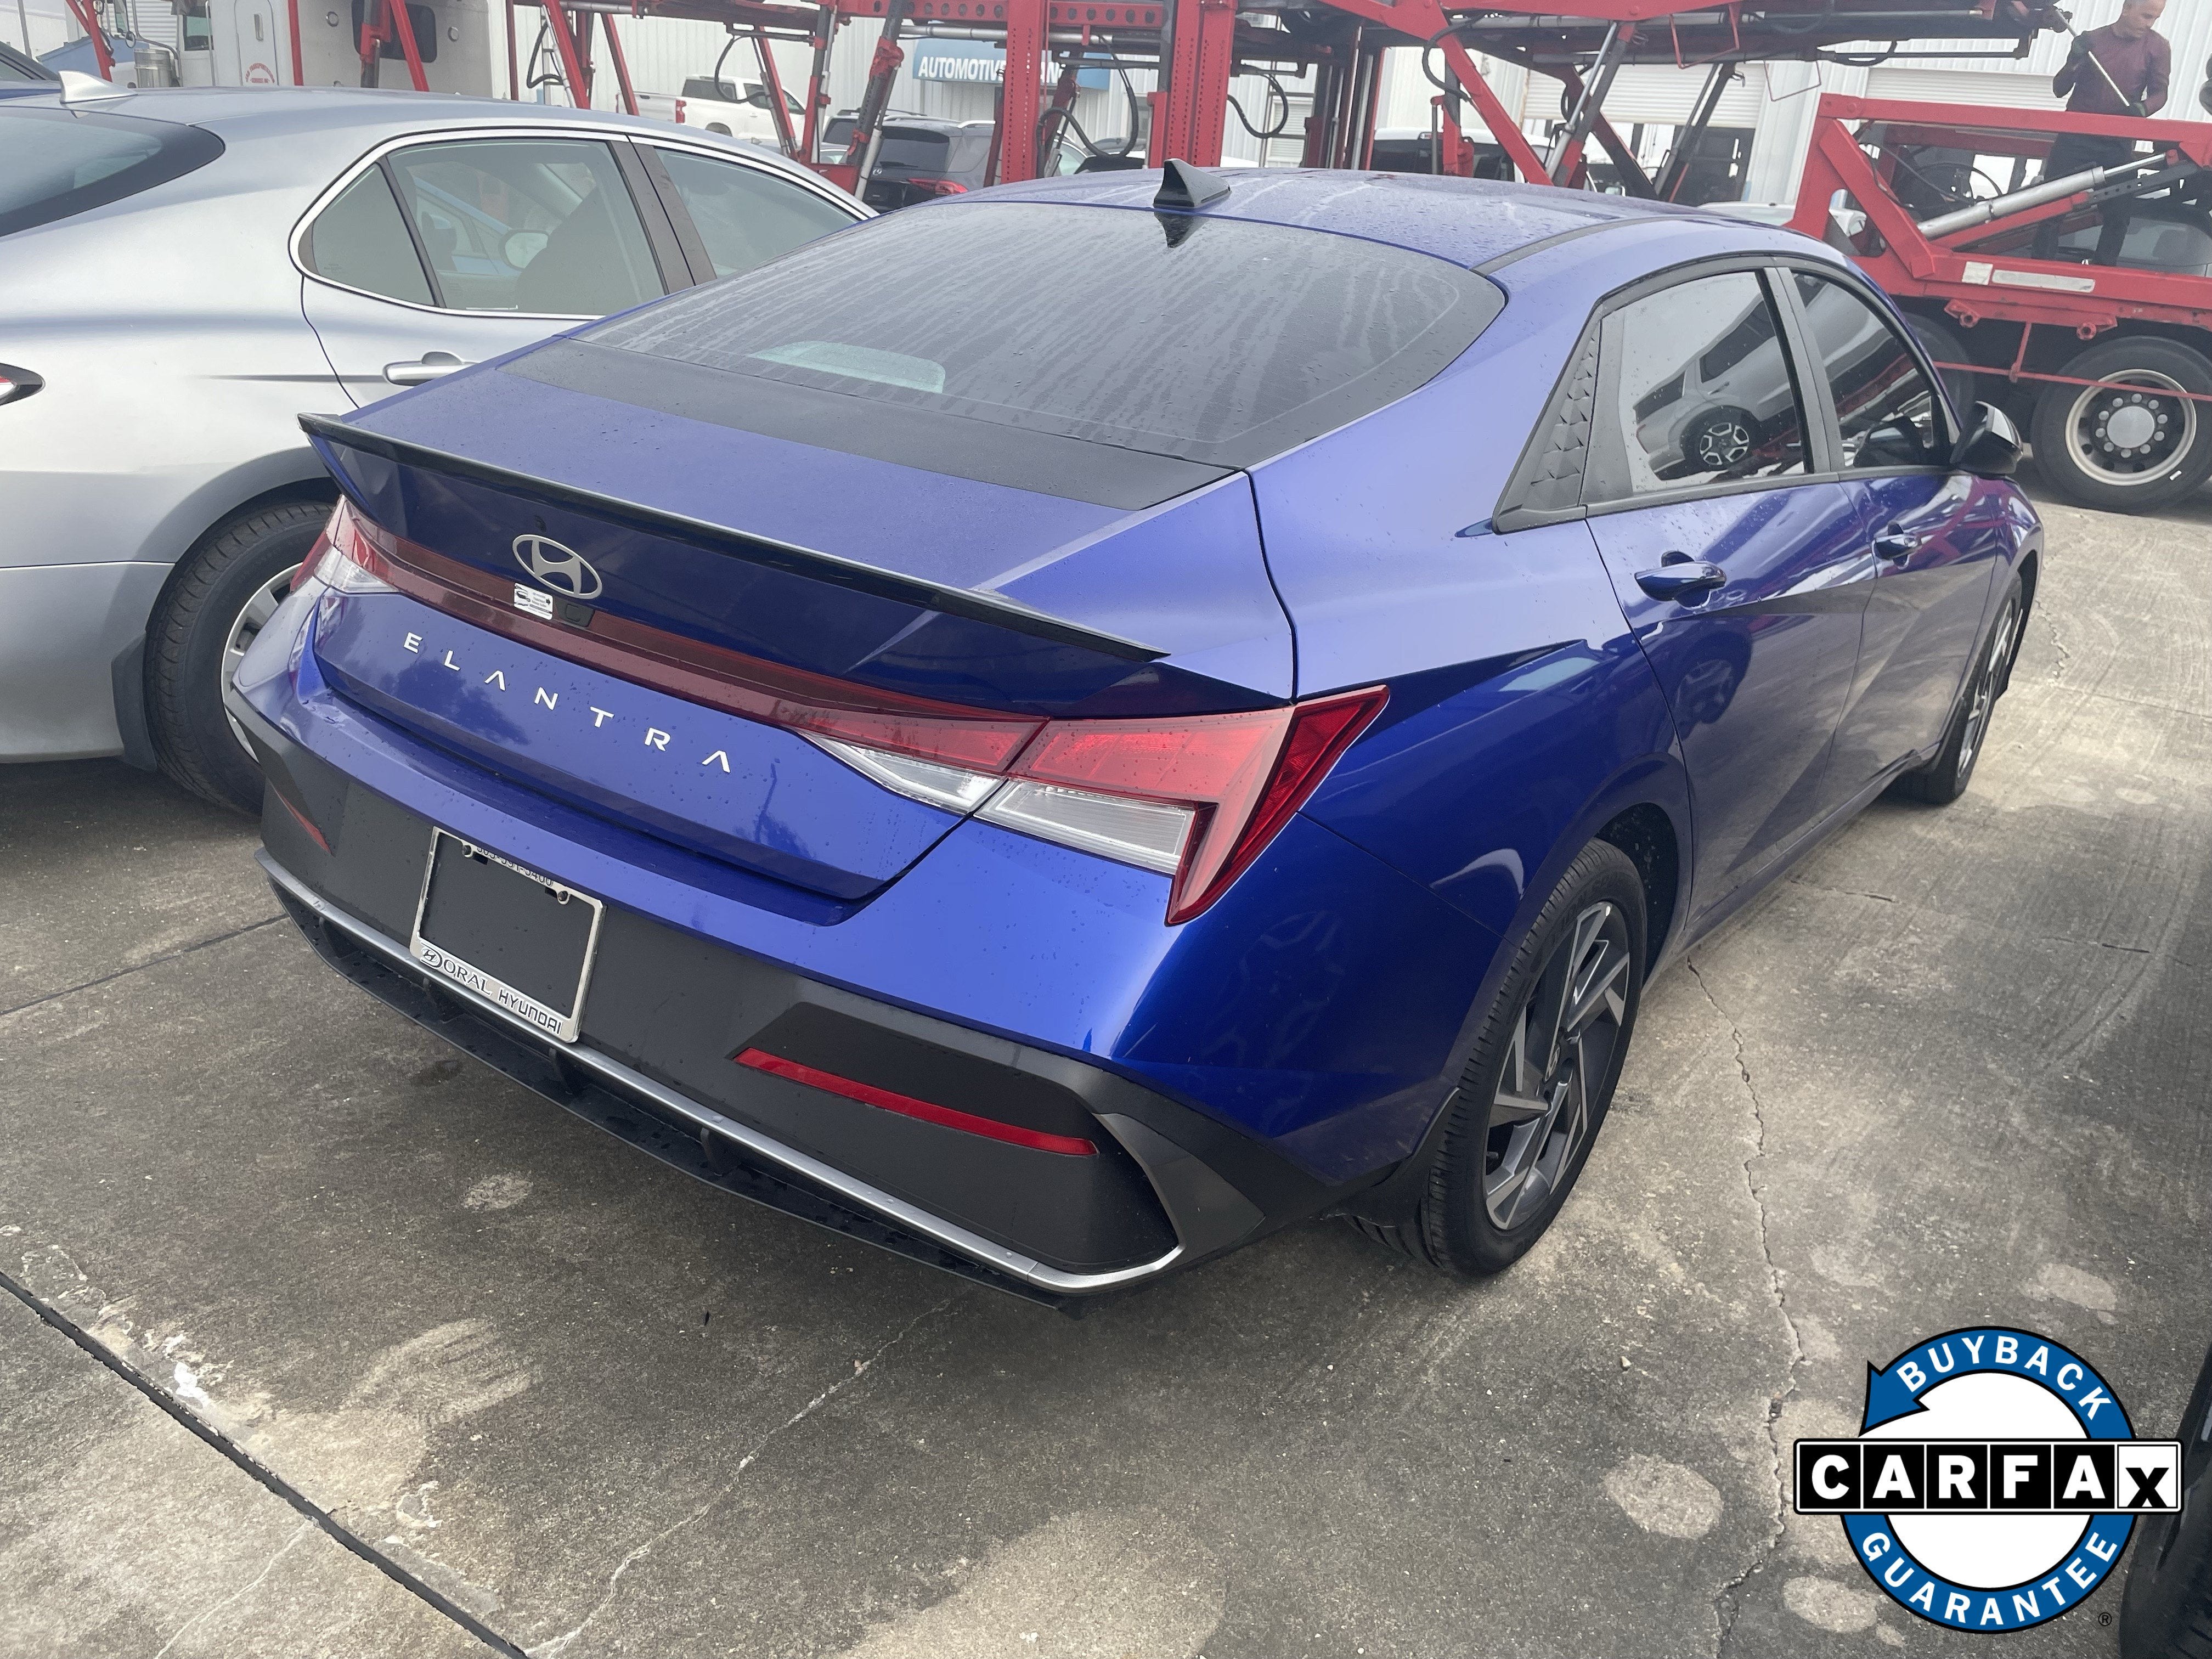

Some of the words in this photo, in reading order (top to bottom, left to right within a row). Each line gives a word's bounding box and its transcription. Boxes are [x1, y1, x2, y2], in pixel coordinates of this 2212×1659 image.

[403, 632, 731, 773] ELANTRA
[421, 942, 491, 995] DORAL
[498, 989, 561, 1034] HYUNDAI
